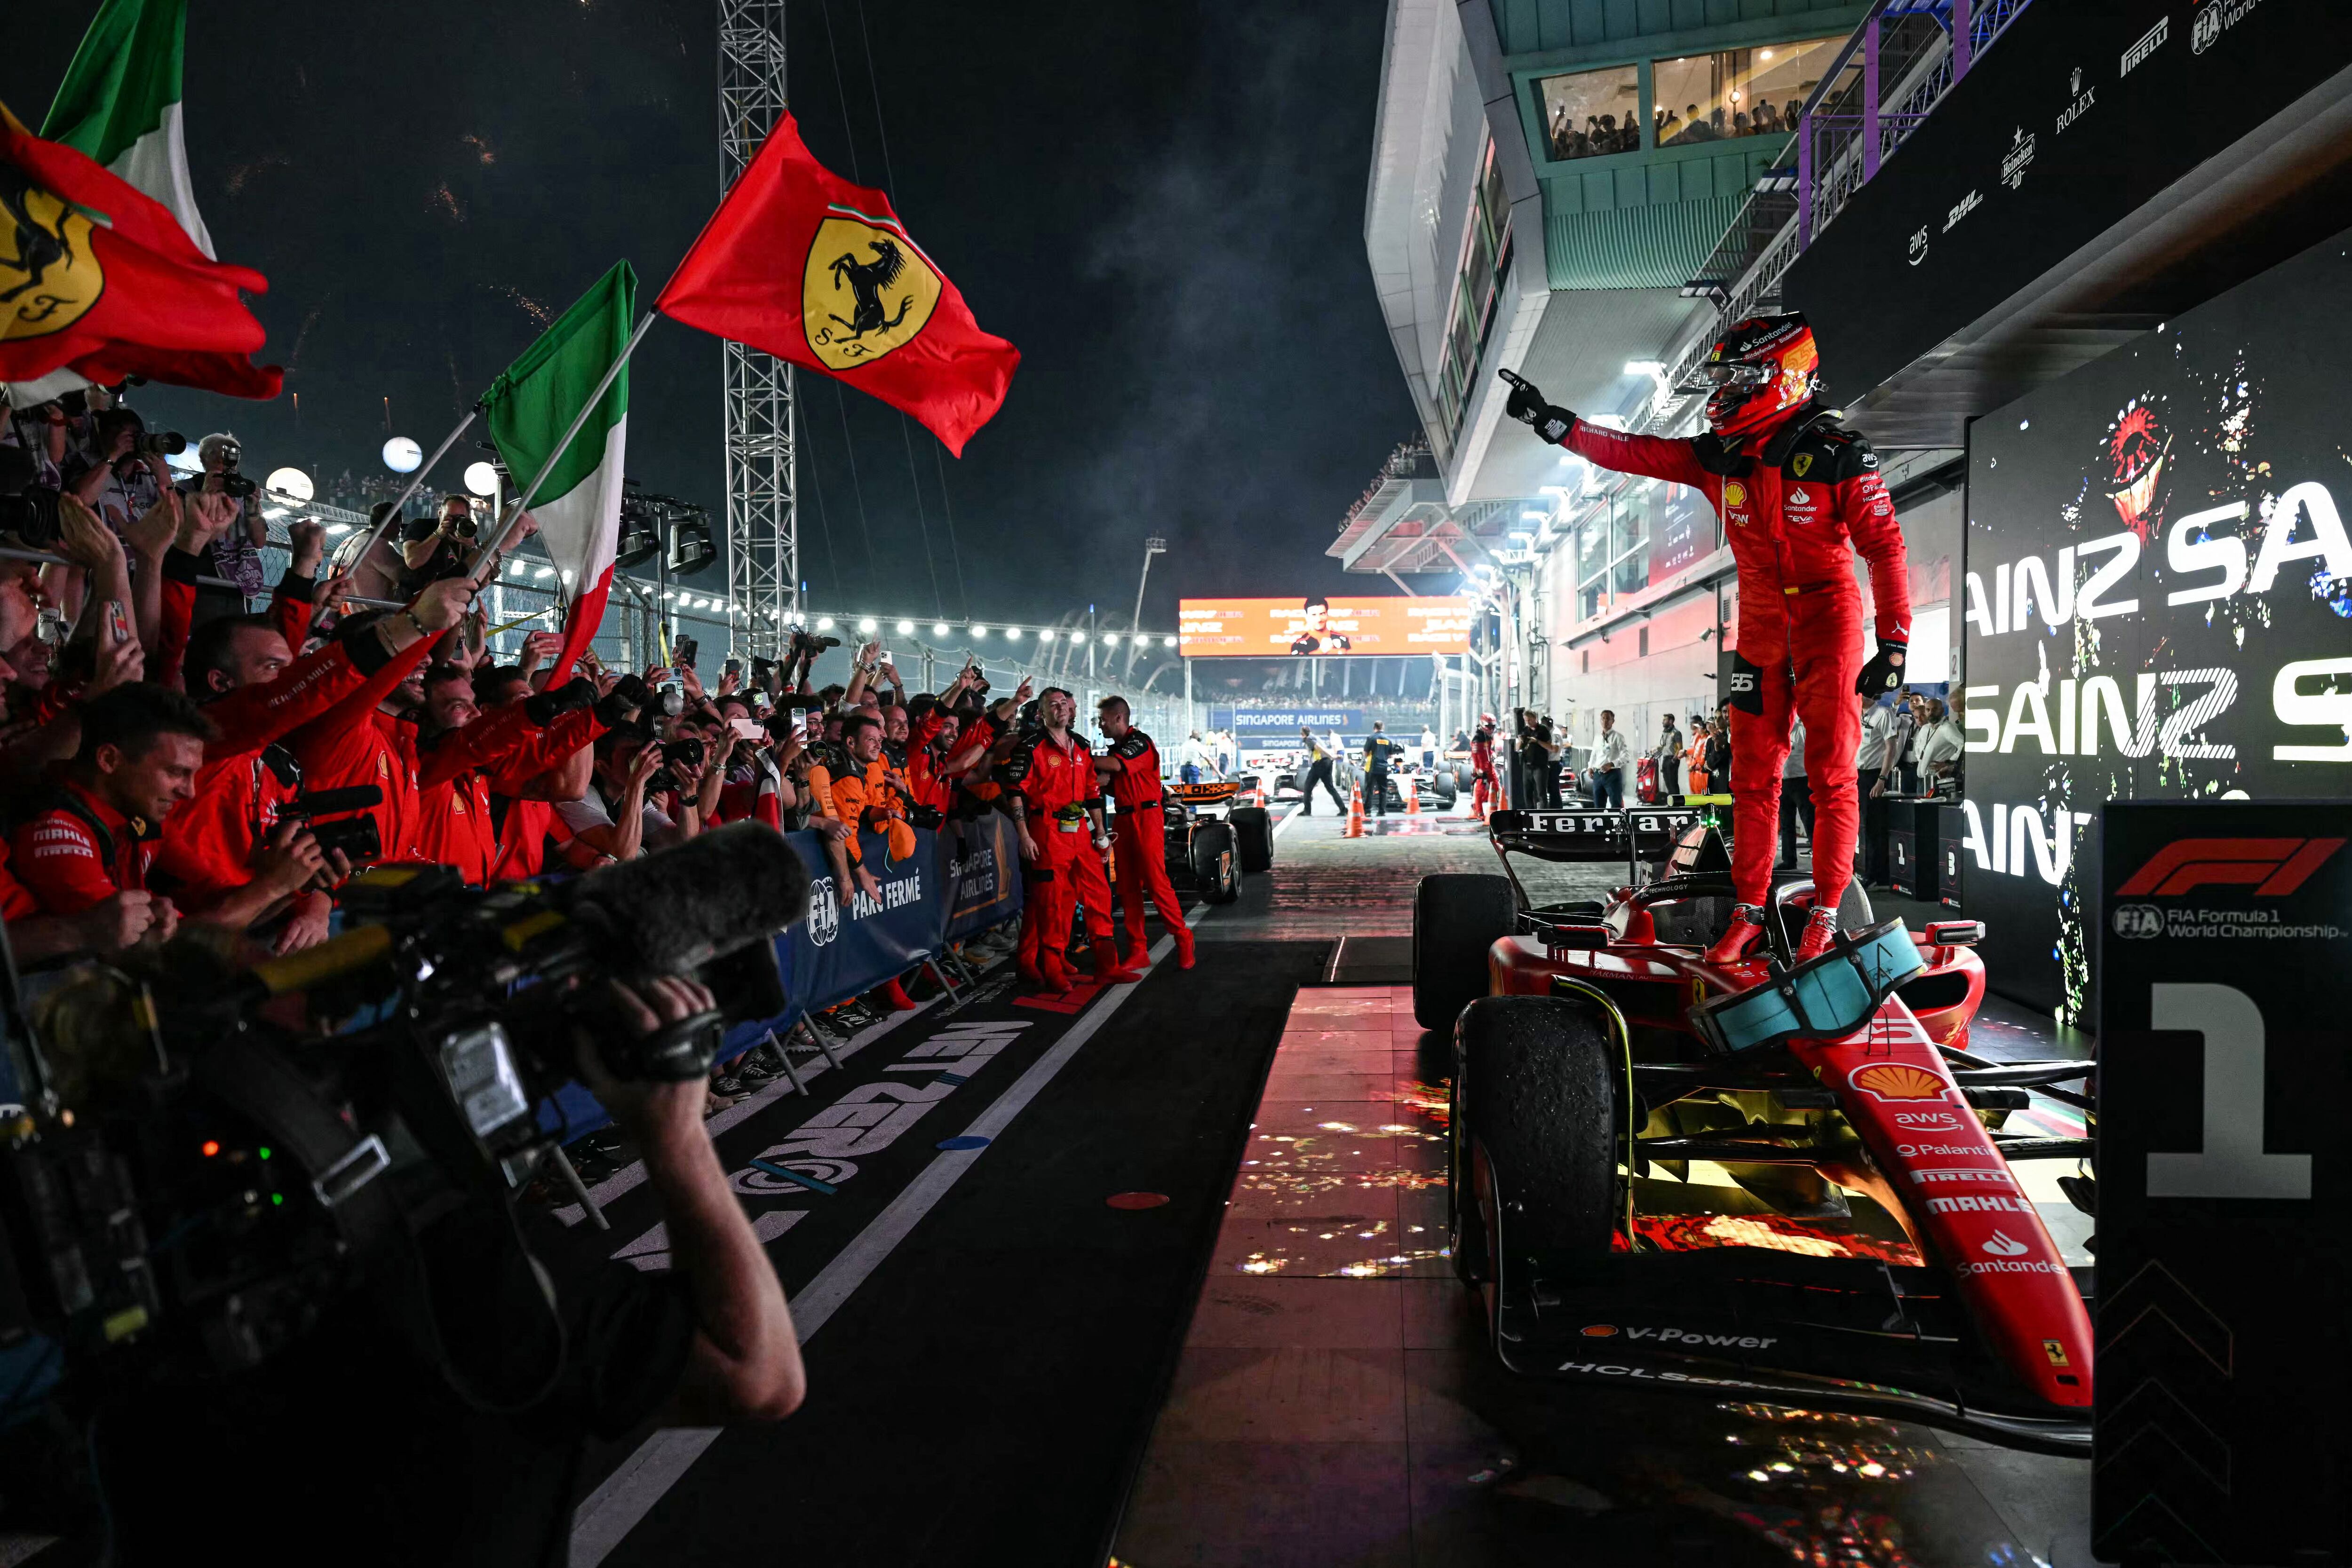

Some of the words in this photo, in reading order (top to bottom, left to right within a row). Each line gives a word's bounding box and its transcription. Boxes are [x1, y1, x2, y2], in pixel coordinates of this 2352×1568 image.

[2121, 16, 2169, 78] PIRELLI
[2056, 87, 2095, 135] ROLEX
[2003, 143, 2033, 178] Heineken
[1947, 189, 1977, 230] DHL
[1909, 225, 1927, 254] aws
[1752, 322, 1793, 347] Santander
[1779, 326, 1803, 344] Bitdefender
[1745, 343, 1776, 360] Bitdefender
[1579, 426, 1608, 437] RICHARD
[1610, 434, 1629, 442] MILLE
[1862, 453, 1877, 462] aws
[307, 659, 336, 682] MILLE
[1952, 654, 1957, 675] 2
[1731, 673, 1754, 691] 55
[1236, 714, 1295, 726] SINGAPORE
[1296, 714, 1342, 725] AIRLINES
[1965, 667, 2238, 759] SAINZ
[33, 828, 90, 848] MAHLE
[1963, 799, 2092, 886] AIN
[34, 845, 94, 859] PIRELLI
[1898, 842, 1905, 865] 1
[1948, 851, 1955, 876] 3
[886, 867, 921, 910] FERMÉ
[960, 872, 993, 901] AIRLINES
[1649, 884, 1688, 894] TECHNOLOGY
[2168, 910, 2195, 923] FIA
[2199, 910, 2269, 923] Formula
[2271, 910, 2280, 923] 1
[2168, 925, 2217, 938] World
[1589, 969, 1635, 980] HARMAN
[2146, 982, 2312, 1199] 1
[1895, 1112, 1957, 1125] aws
[1922, 1144, 1995, 1156] Palantir
[1910, 1169, 2014, 1184] PIRELLI
[1926, 1196, 2036, 1215] MAHLE
[1626, 1327, 1777, 1349] V-Power
